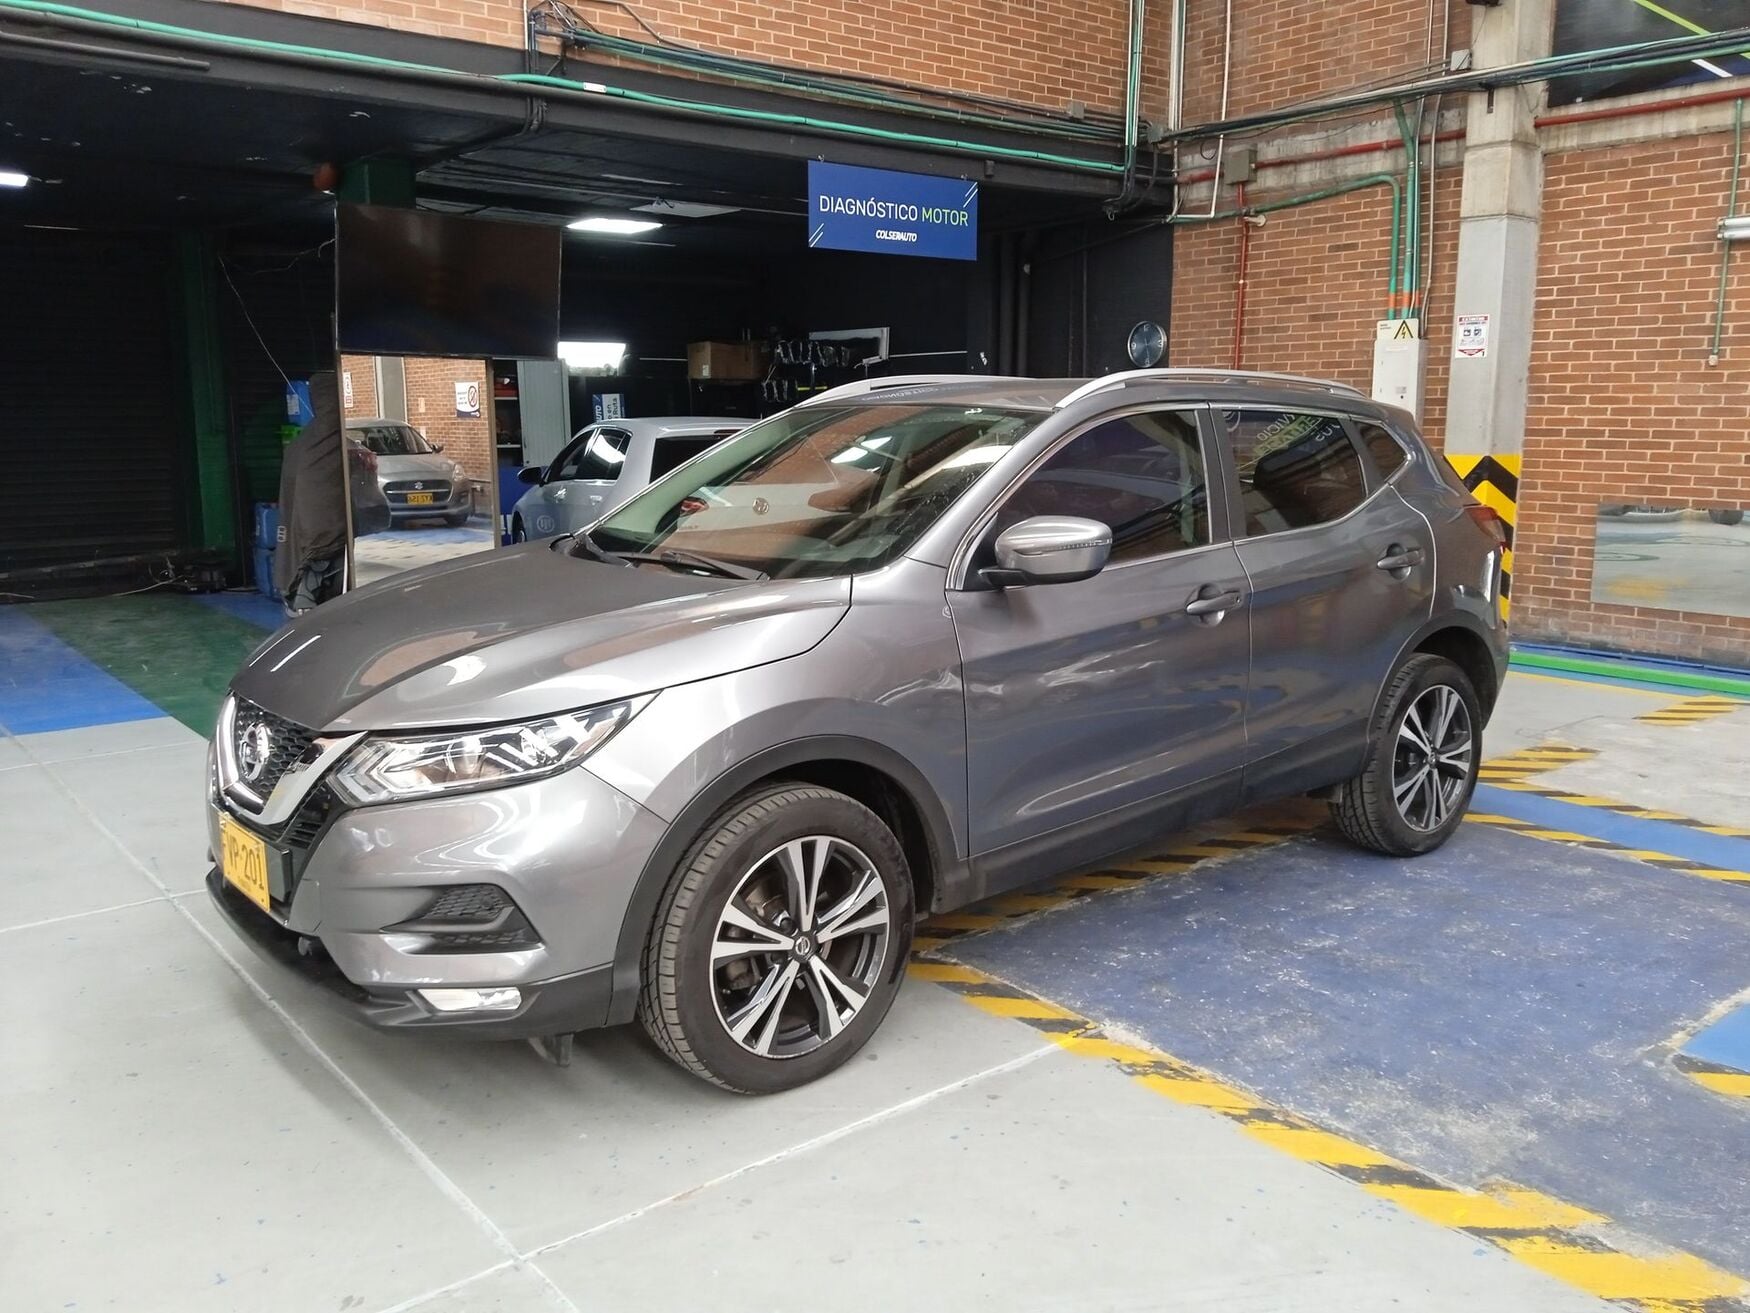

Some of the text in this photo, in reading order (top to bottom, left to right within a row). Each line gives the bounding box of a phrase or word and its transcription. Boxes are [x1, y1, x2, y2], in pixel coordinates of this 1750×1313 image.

[819, 195, 968, 226] DIAGNÓSTICO MOTOR
[875, 229, 917, 242] COLSERAUTO
